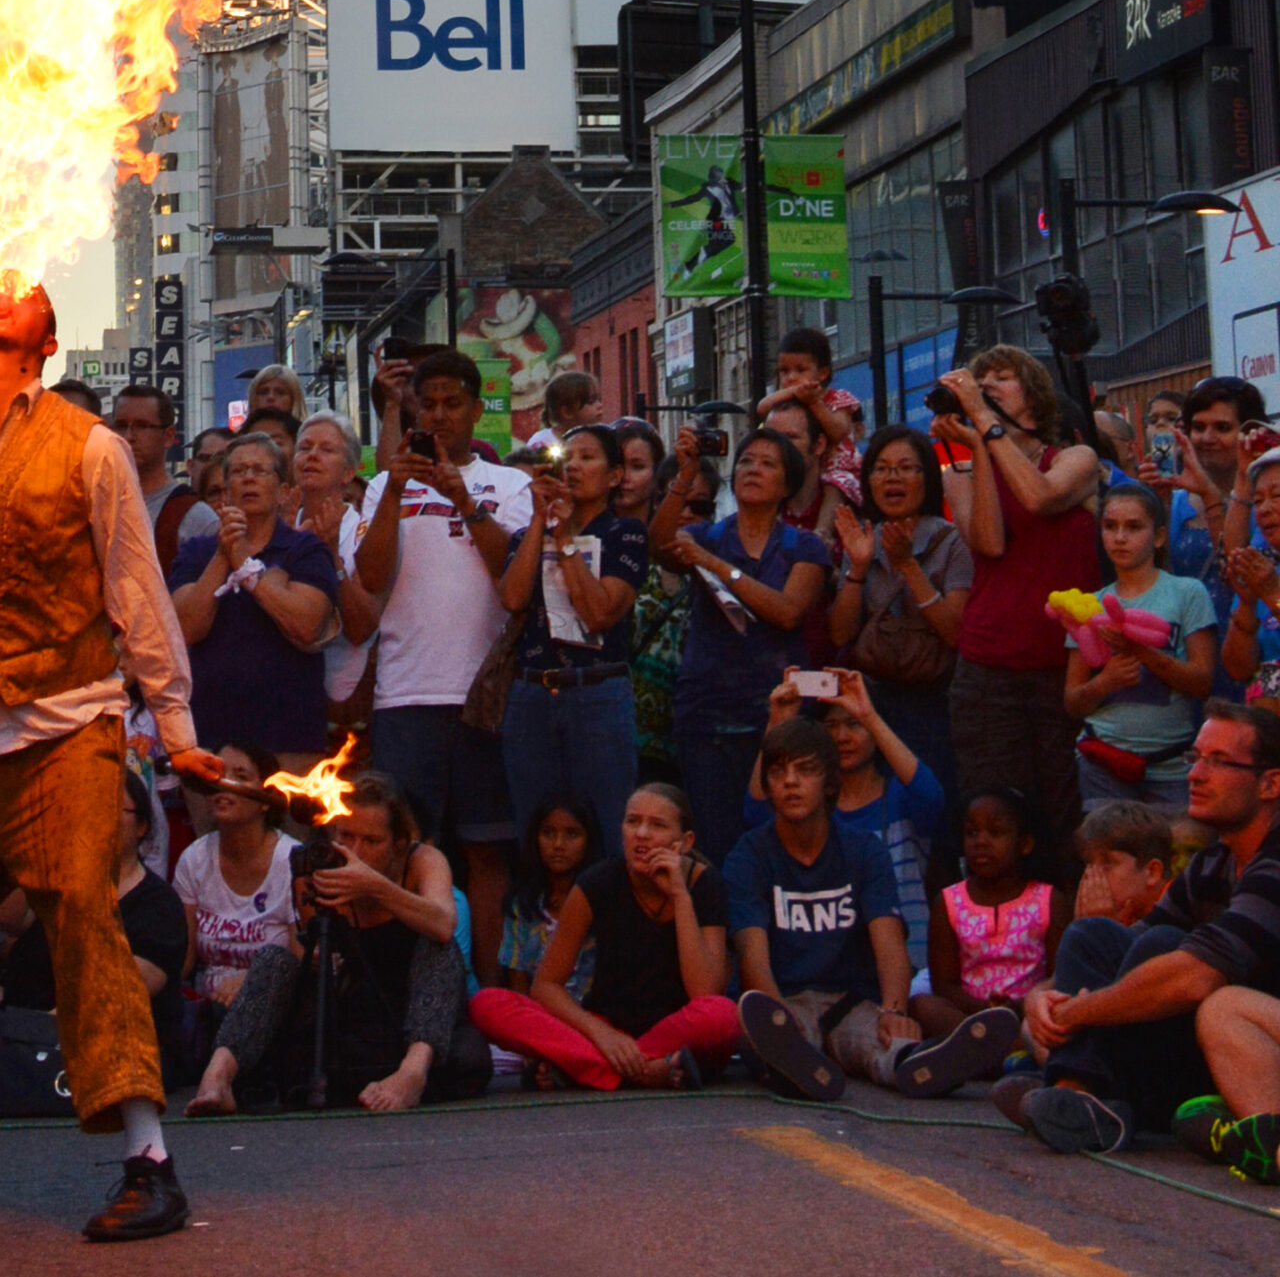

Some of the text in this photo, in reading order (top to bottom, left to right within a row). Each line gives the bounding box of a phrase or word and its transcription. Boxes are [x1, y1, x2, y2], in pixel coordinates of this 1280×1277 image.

[1211, 65, 1240, 83] BAR
[665, 134, 735, 158] LIVE
[944, 194, 969, 209] BAR
[1241, 353, 1277, 381] Canon
[773, 883, 857, 933] VANS
